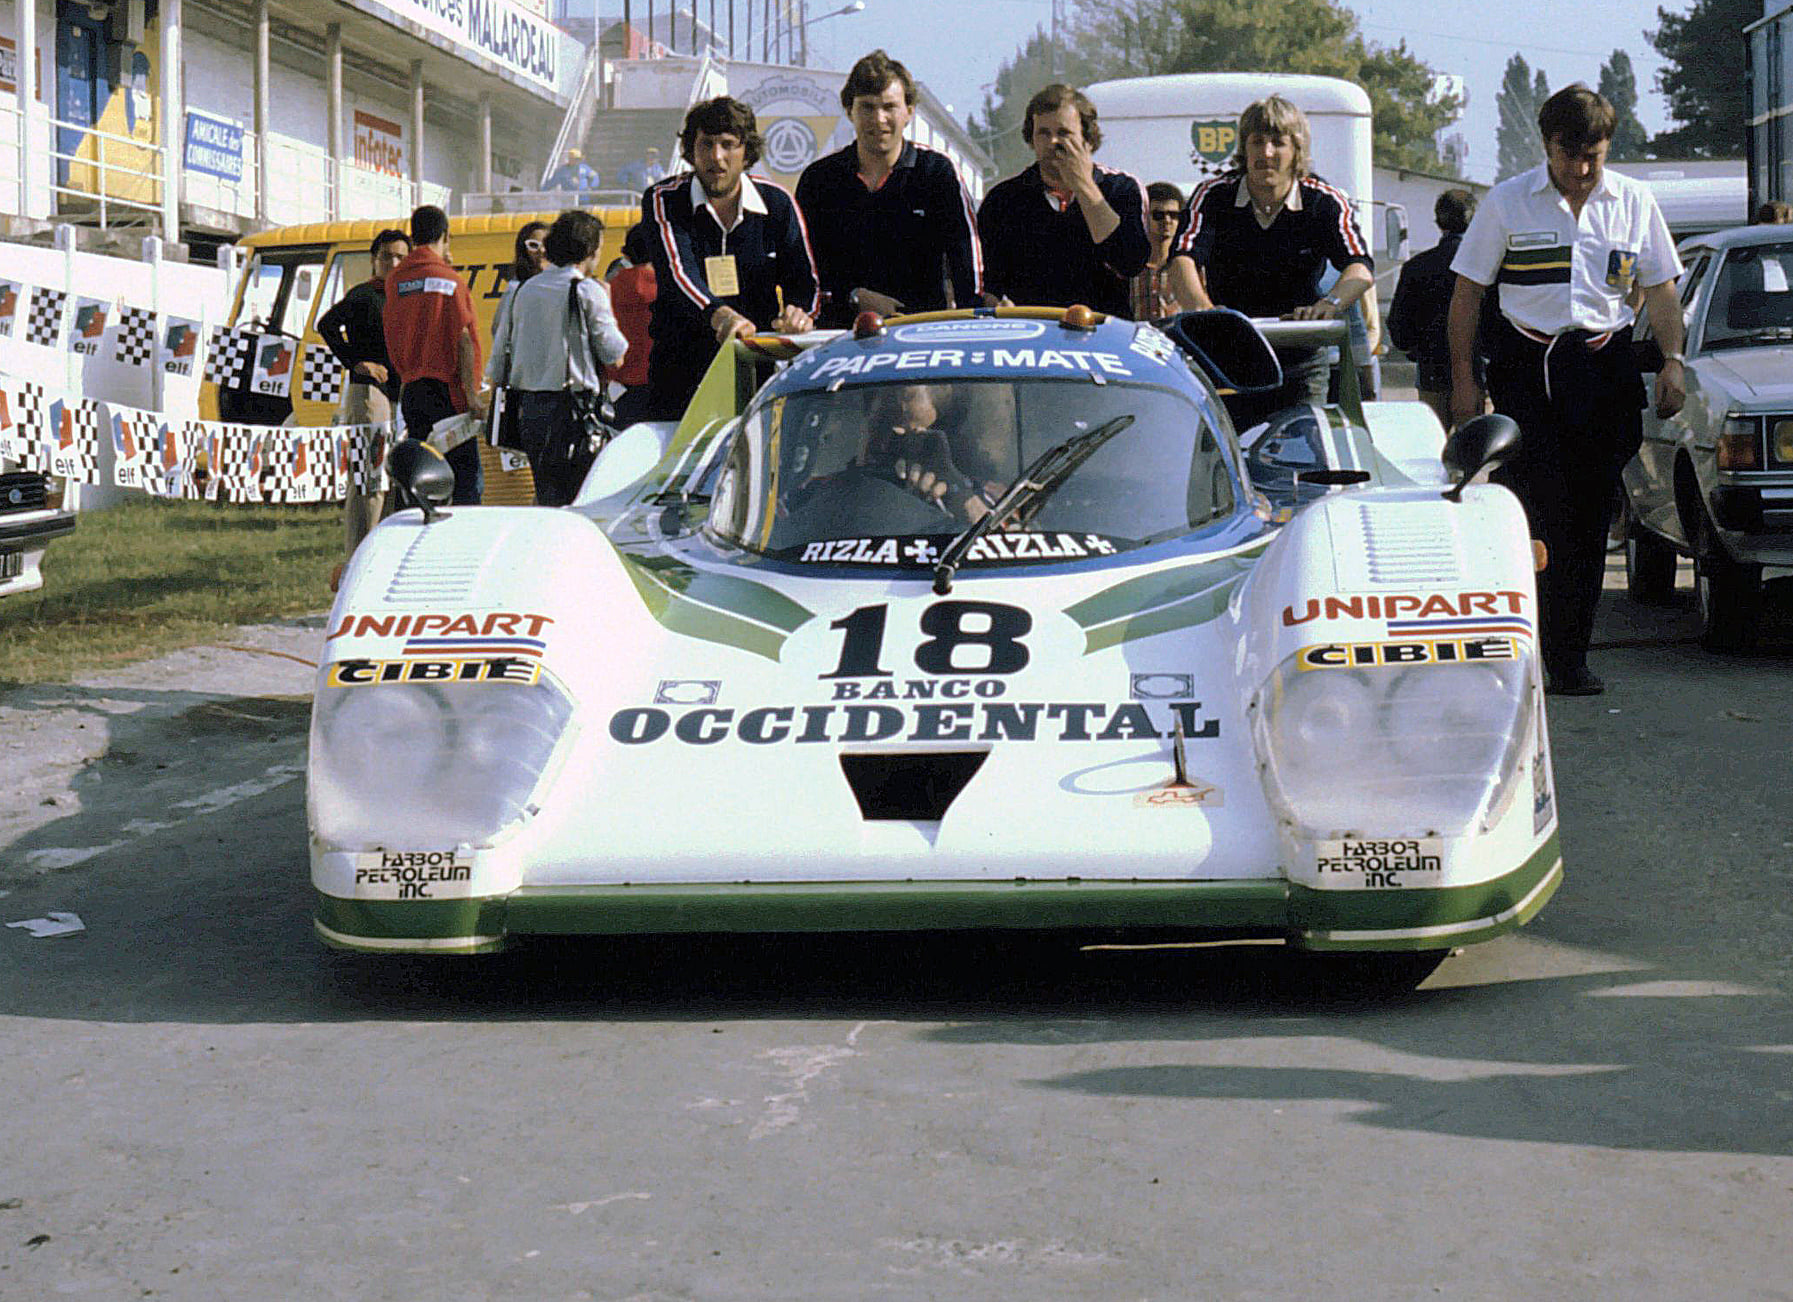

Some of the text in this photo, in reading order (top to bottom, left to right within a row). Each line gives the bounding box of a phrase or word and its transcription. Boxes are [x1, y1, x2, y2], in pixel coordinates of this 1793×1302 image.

[468, 0, 555, 83] MALARDEAU
[191, 119, 228, 148] AMICALE
[1198, 127, 1236, 153] BP
[74, 341, 98, 356] elf
[165, 360, 190, 376] elf
[809, 349, 965, 380] PAPER
[992, 349, 1133, 376] MATE
[259, 379, 285, 395] elf
[55, 457, 76, 476] elf
[118, 467, 136, 485] elf
[800, 538, 899, 563] RIZLA
[1282, 591, 1529, 627] UNIPART
[818, 599, 1033, 680] 18
[831, 679, 1007, 701] BANCO
[608, 701, 1220, 745] OCCIDENTAL
[381, 851, 456, 867] HARBOR
[1342, 840, 1421, 857] HARBOR
